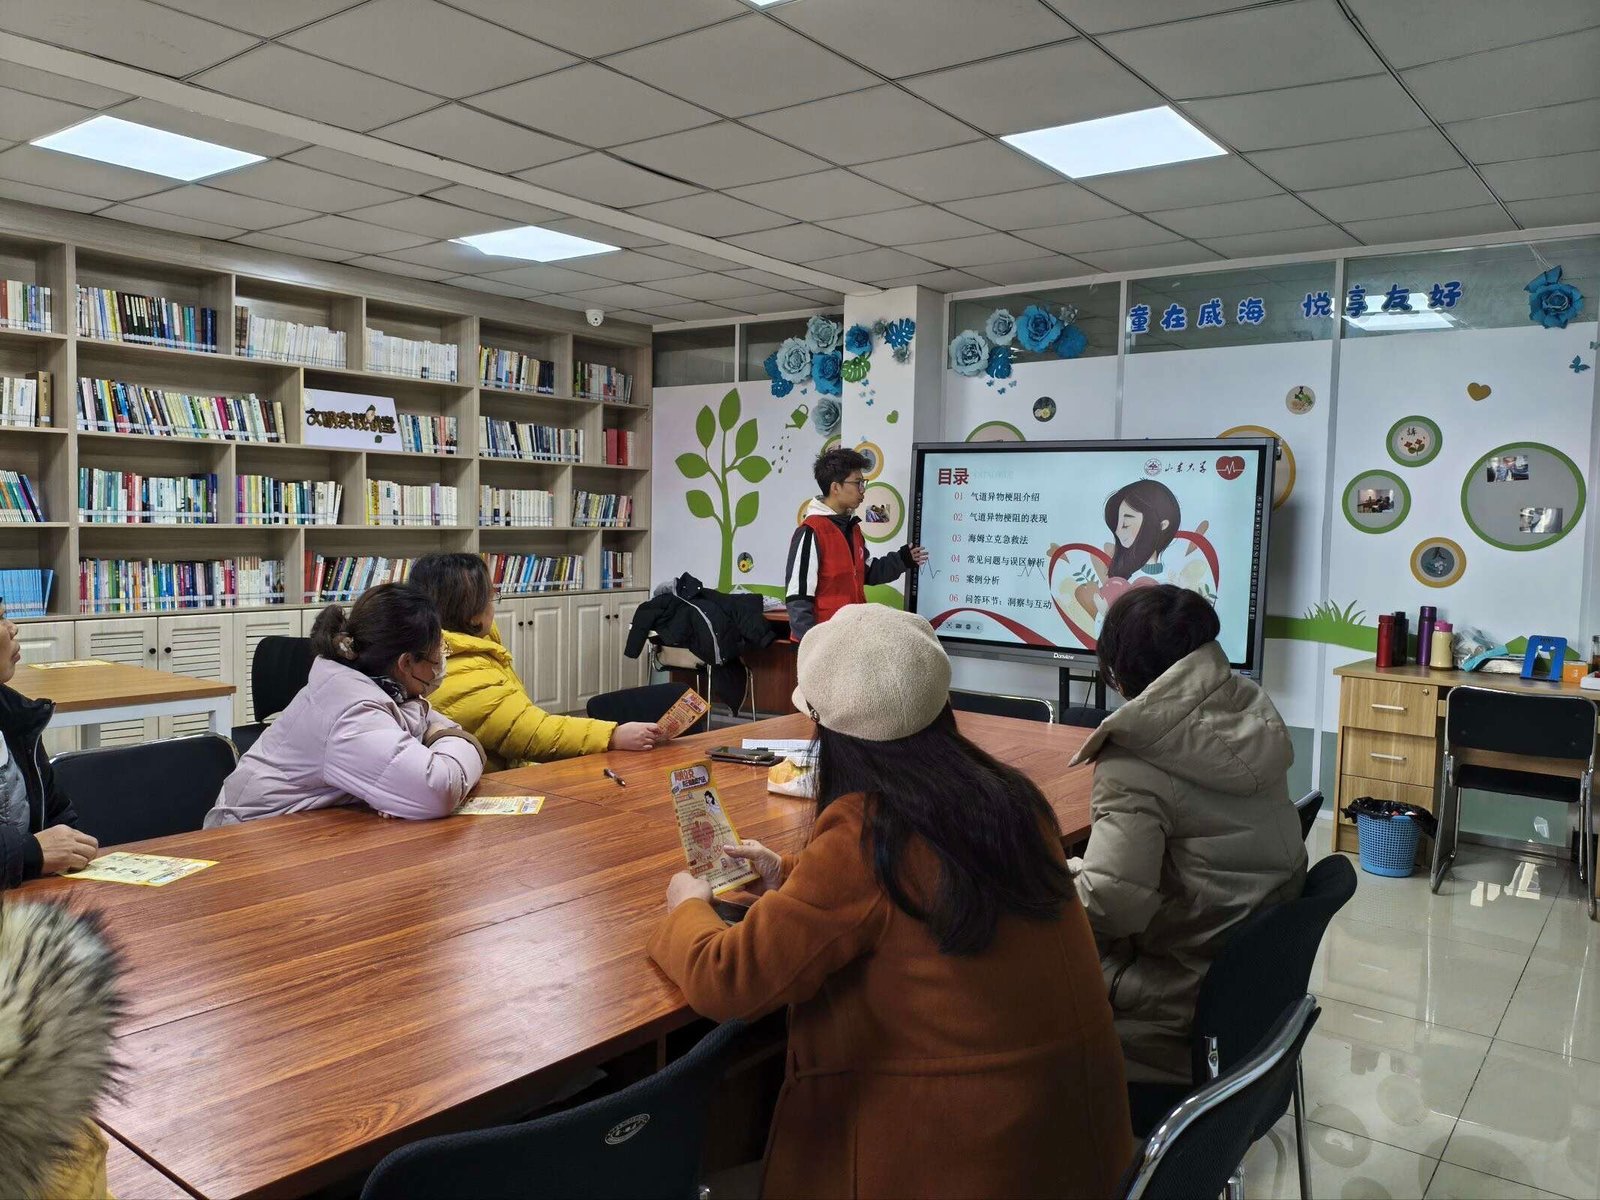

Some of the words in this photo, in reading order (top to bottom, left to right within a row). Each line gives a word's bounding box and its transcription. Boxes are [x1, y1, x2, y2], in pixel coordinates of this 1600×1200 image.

[1129, 297, 1265, 333] 童在威海
[1302, 281, 1463, 319] 悦享友好
[938, 467, 969, 486] 目录
[954, 491, 963, 500] 01
[970, 491, 1040, 502] 气道异物梗阻介绍
[953, 513, 963, 522] 02
[969, 512, 1048, 524] 气道异物梗阻的表现
[952, 534, 962, 543] 03
[967, 533, 1029, 545] 海姆立克急救法
[951, 555, 961, 563] 04
[967, 554, 1045, 567] 常见问题与误区解析
[950, 575, 960, 583] 05
[966, 575, 1000, 585] 案例分析
[949, 594, 959, 602] 06
